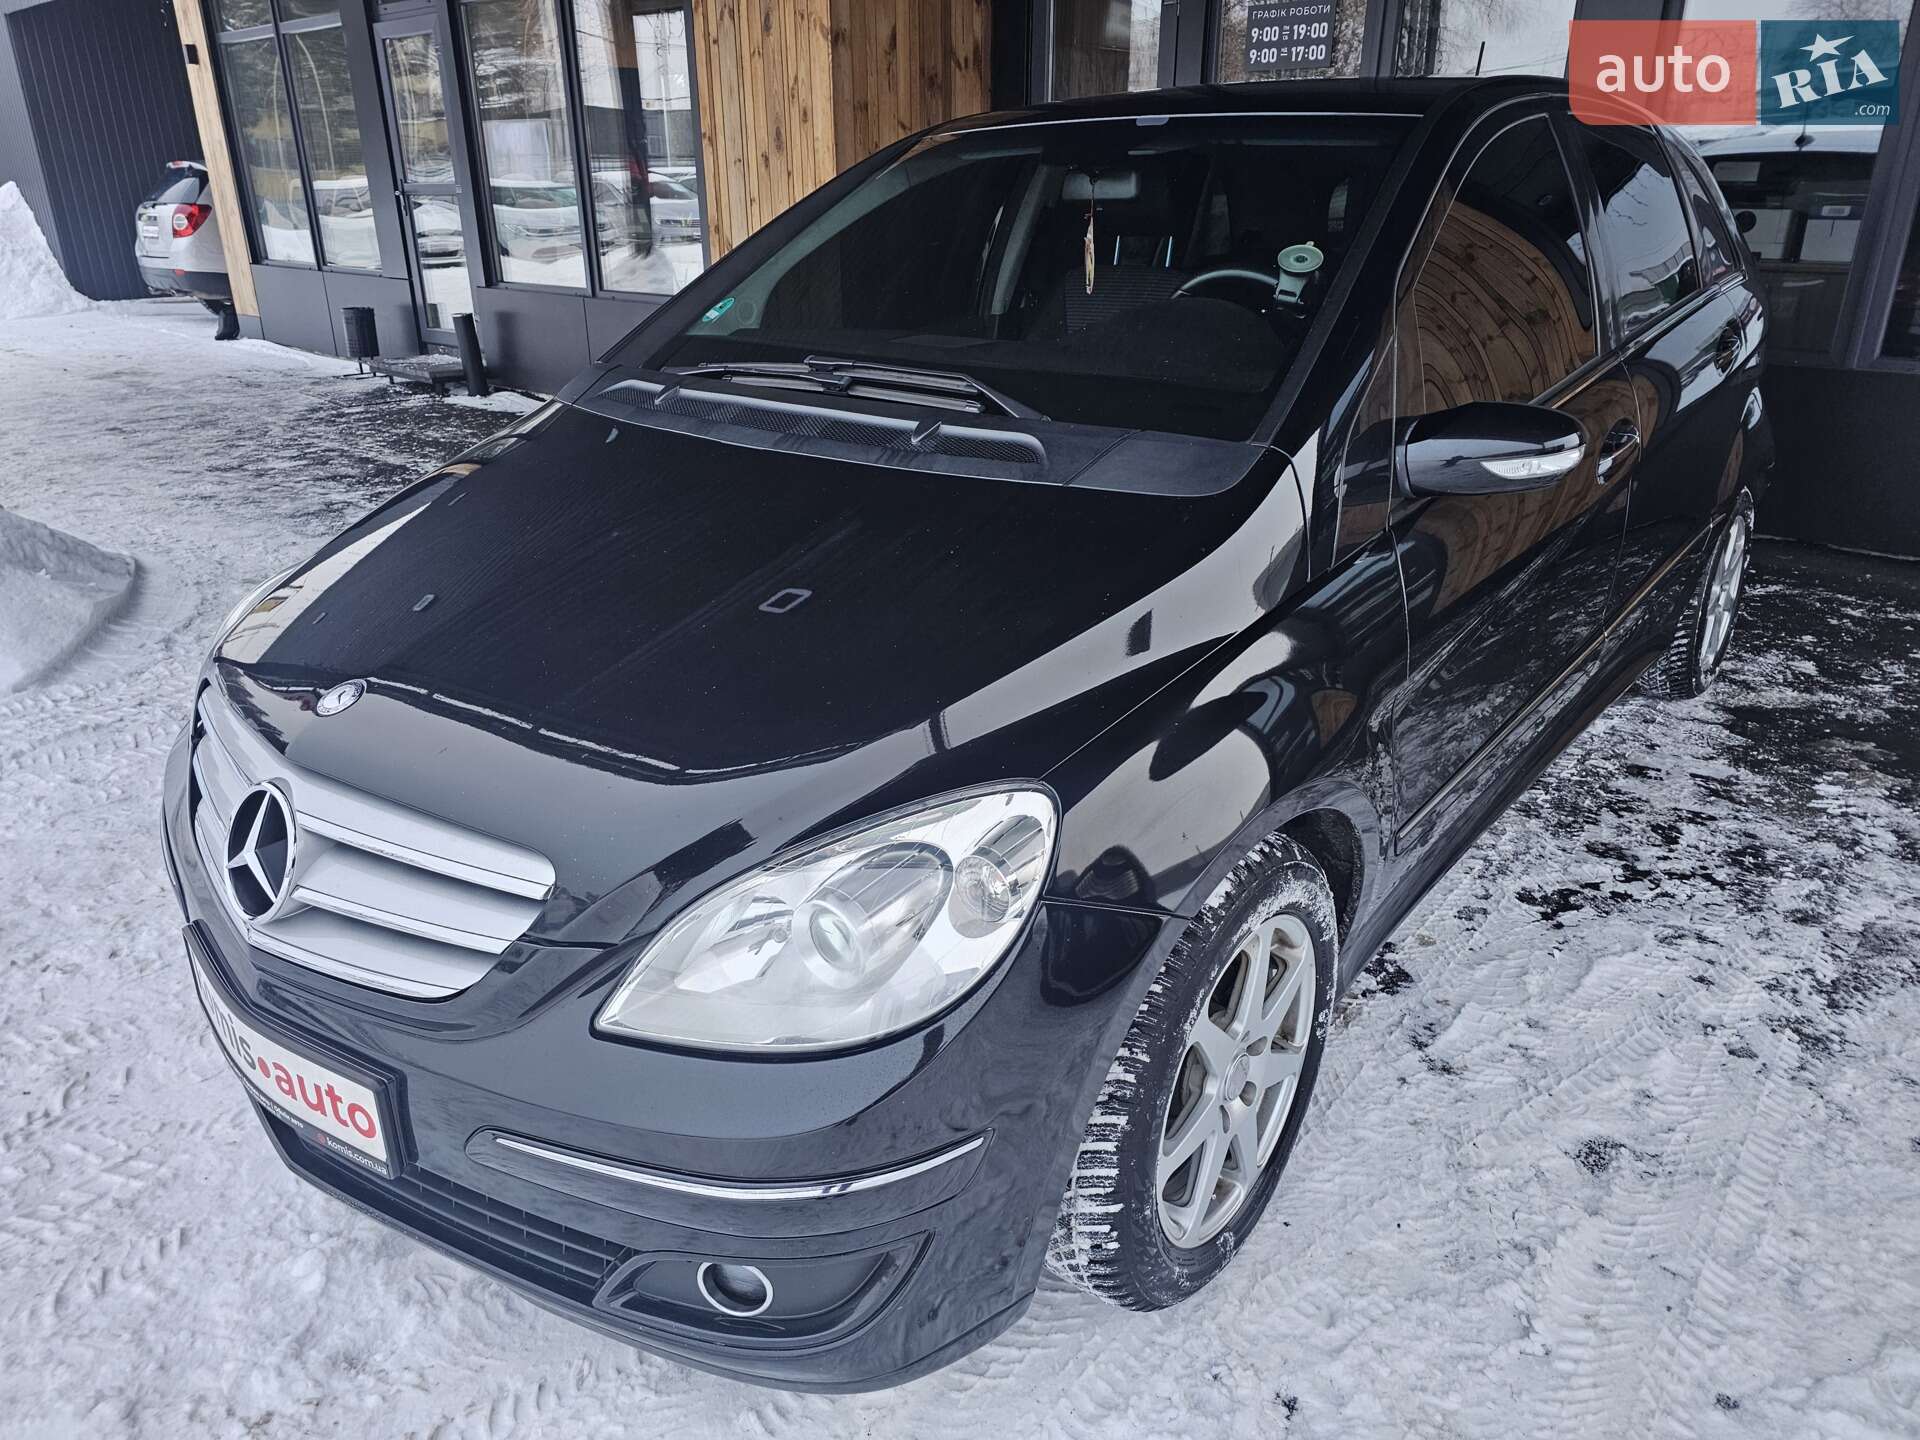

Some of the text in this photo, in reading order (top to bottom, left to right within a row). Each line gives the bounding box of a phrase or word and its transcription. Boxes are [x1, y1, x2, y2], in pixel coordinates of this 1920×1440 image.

[1252, 4, 1331, 20] ГРАФІК РОБОТИ
[1251, 22, 1329, 43] 9:00 19:00
[1249, 44, 1327, 64] 9:00 17:00
